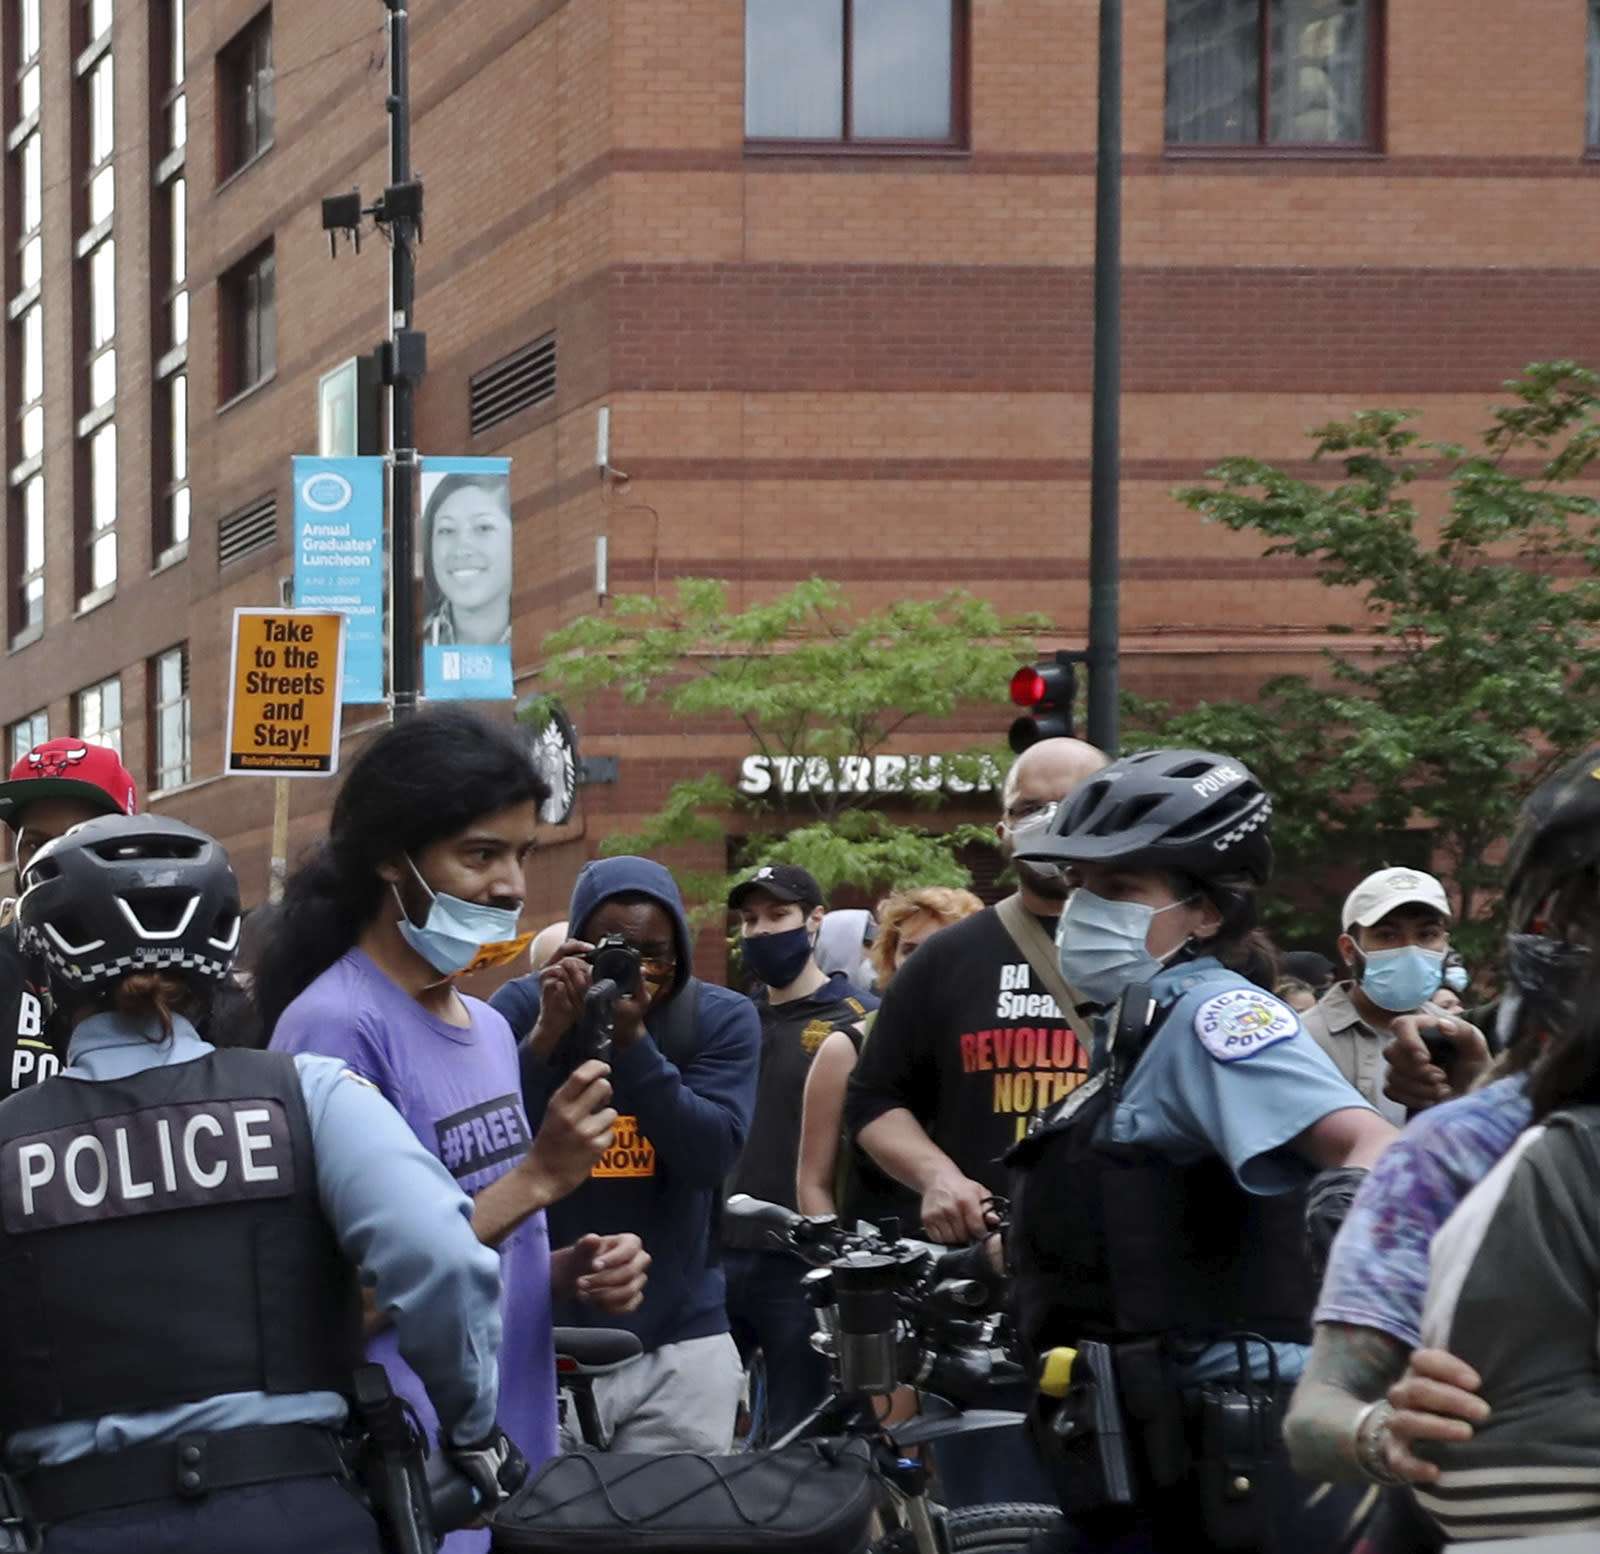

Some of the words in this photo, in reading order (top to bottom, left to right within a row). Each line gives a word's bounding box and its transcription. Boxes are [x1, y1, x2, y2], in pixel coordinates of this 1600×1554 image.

[302, 523, 351, 537] Annual
[302, 552, 371, 567] Luncheon
[263, 618, 314, 643] Take
[255, 646, 276, 668] to
[283, 646, 319, 669] the
[245, 670, 325, 696] Streets
[262, 698, 304, 721] and
[253, 723, 310, 752] Stay!
[738, 753, 1003, 794] STARBUCK
[1191, 764, 1244, 798] POLICE
[999, 963, 1031, 990] BA
[996, 990, 1067, 1020] Spea
[1203, 992, 1276, 1034] CHICAGO
[1224, 1016, 1291, 1048] POLICE
[440, 1107, 523, 1168] #FREE
[16, 1107, 280, 1218] POLICE
